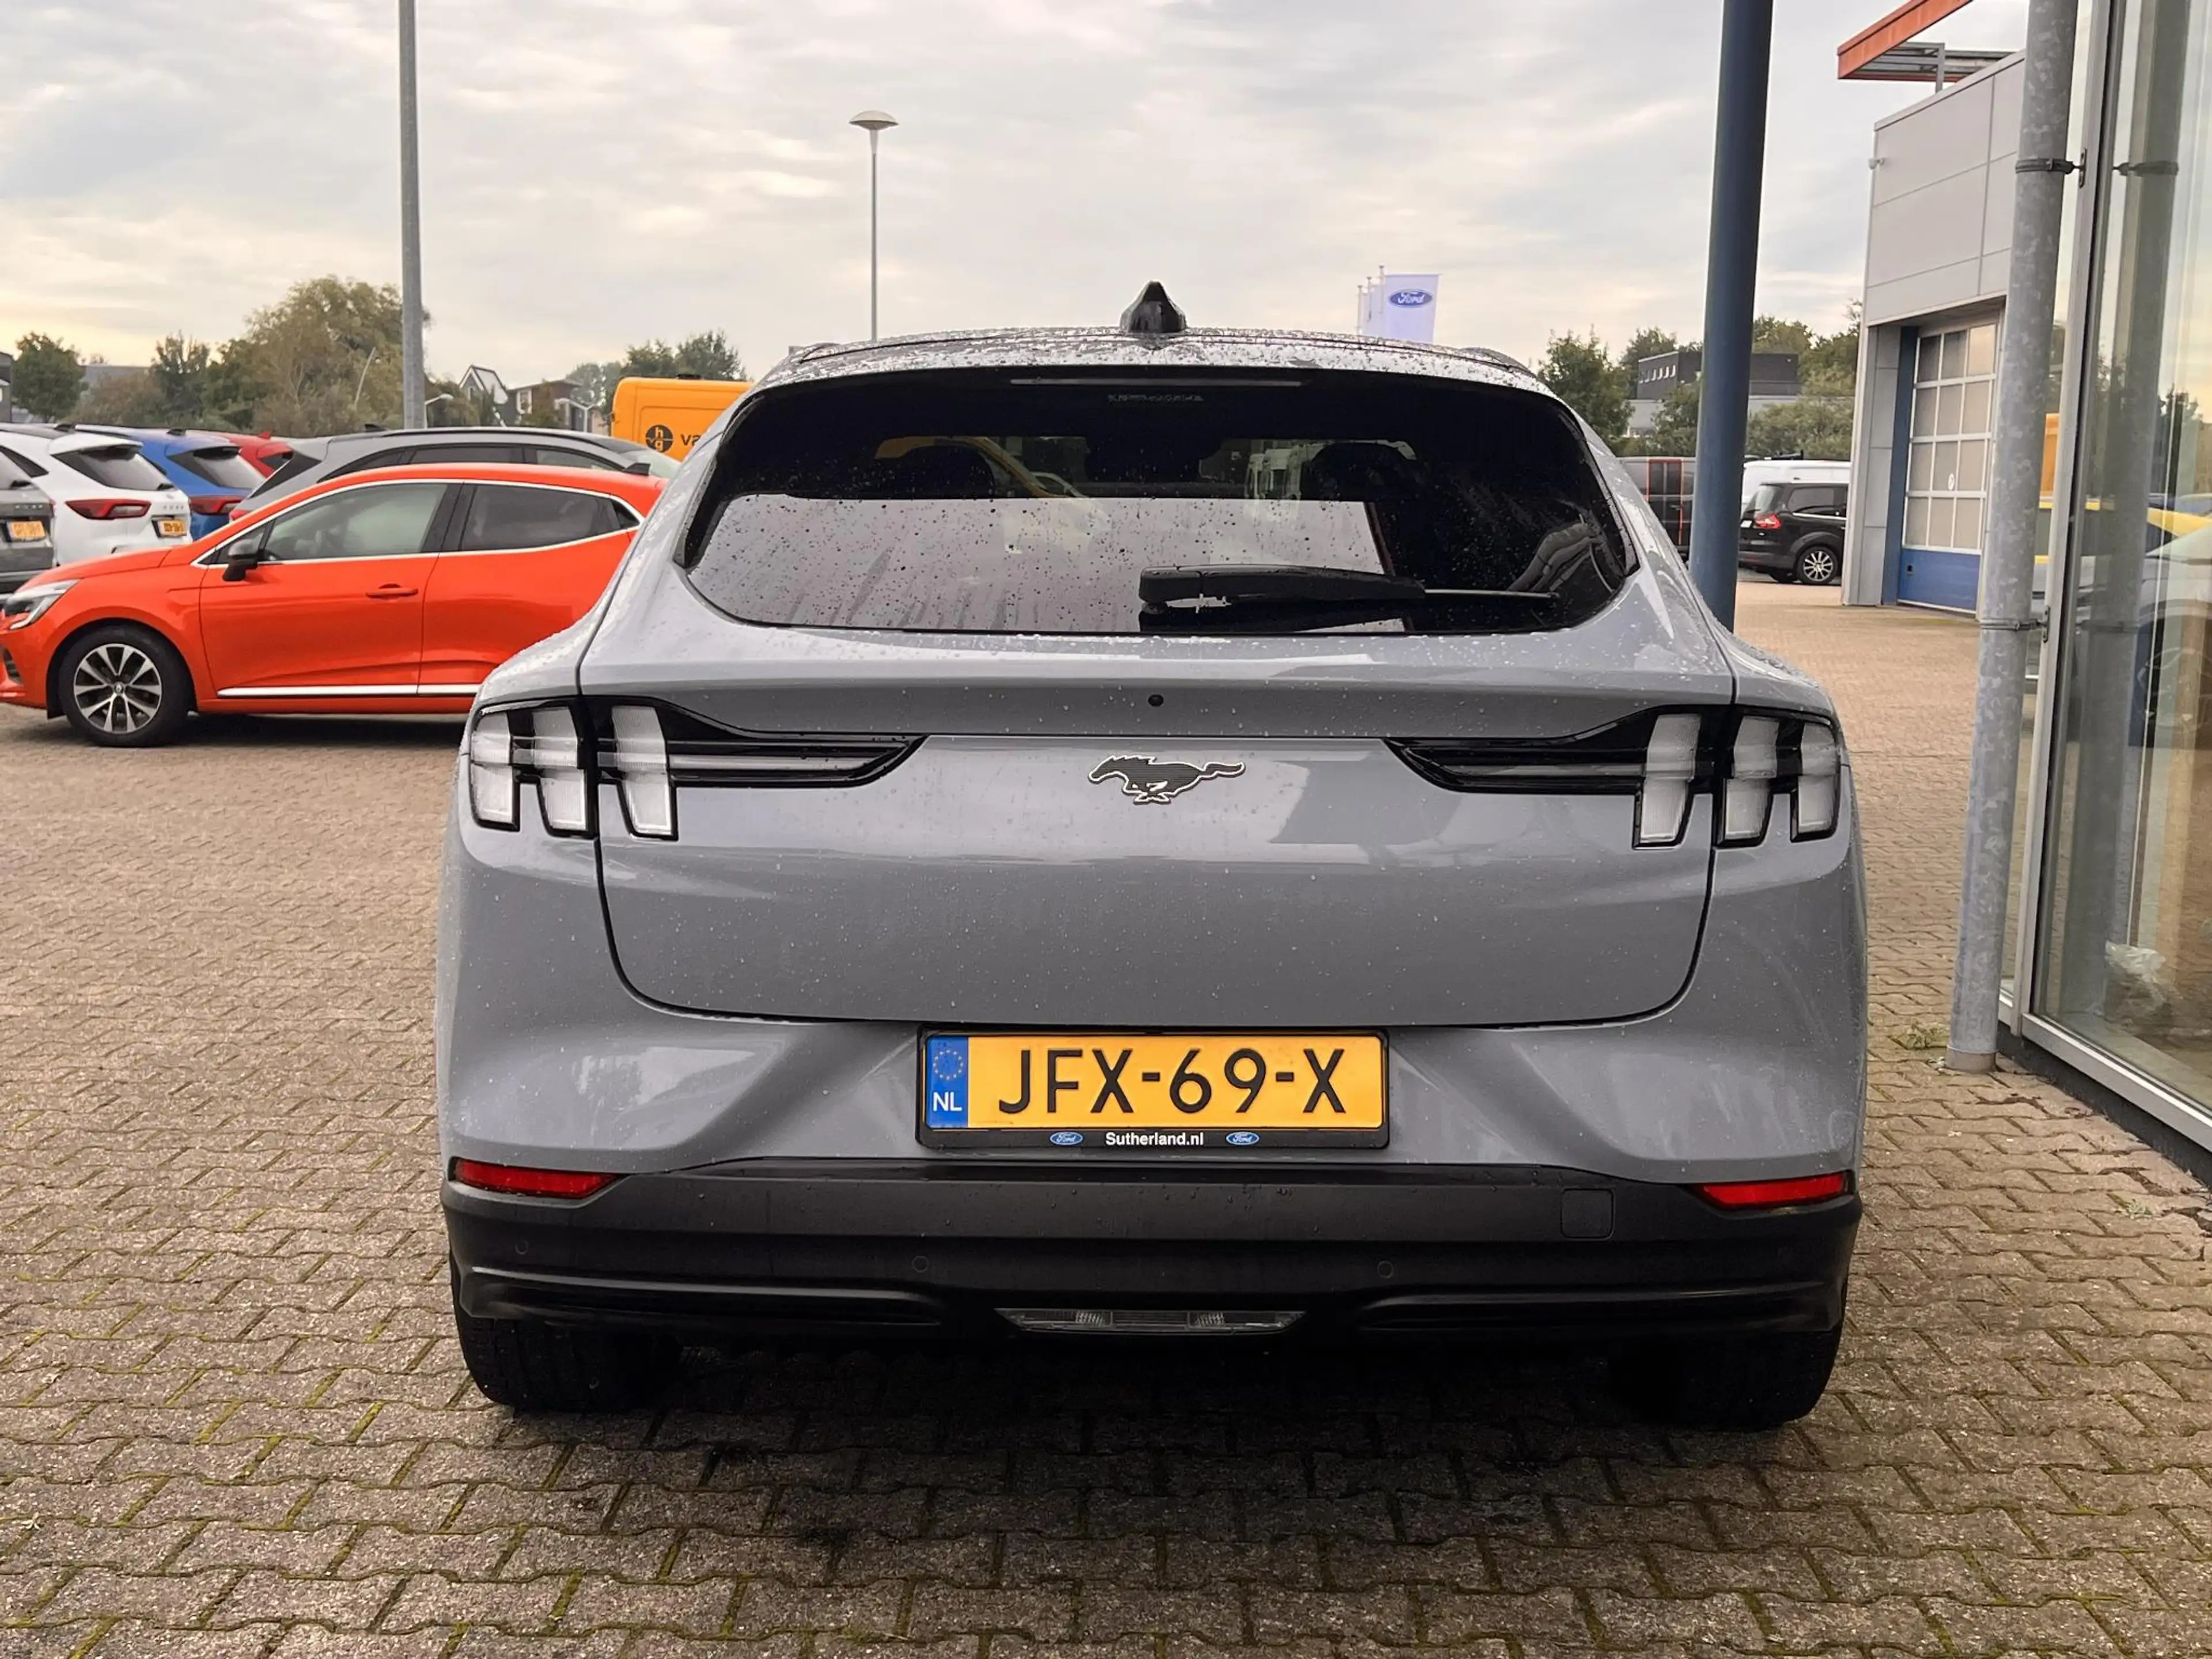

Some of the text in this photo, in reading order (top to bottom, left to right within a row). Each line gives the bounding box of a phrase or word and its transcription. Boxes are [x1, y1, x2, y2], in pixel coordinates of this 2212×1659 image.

[1398, 291, 1425, 304] Ford
[999, 1048, 1346, 1114] JFX-69-X
[933, 1092, 962, 1111] NL
[1105, 1131, 1203, 1145] Sutherland.nl
